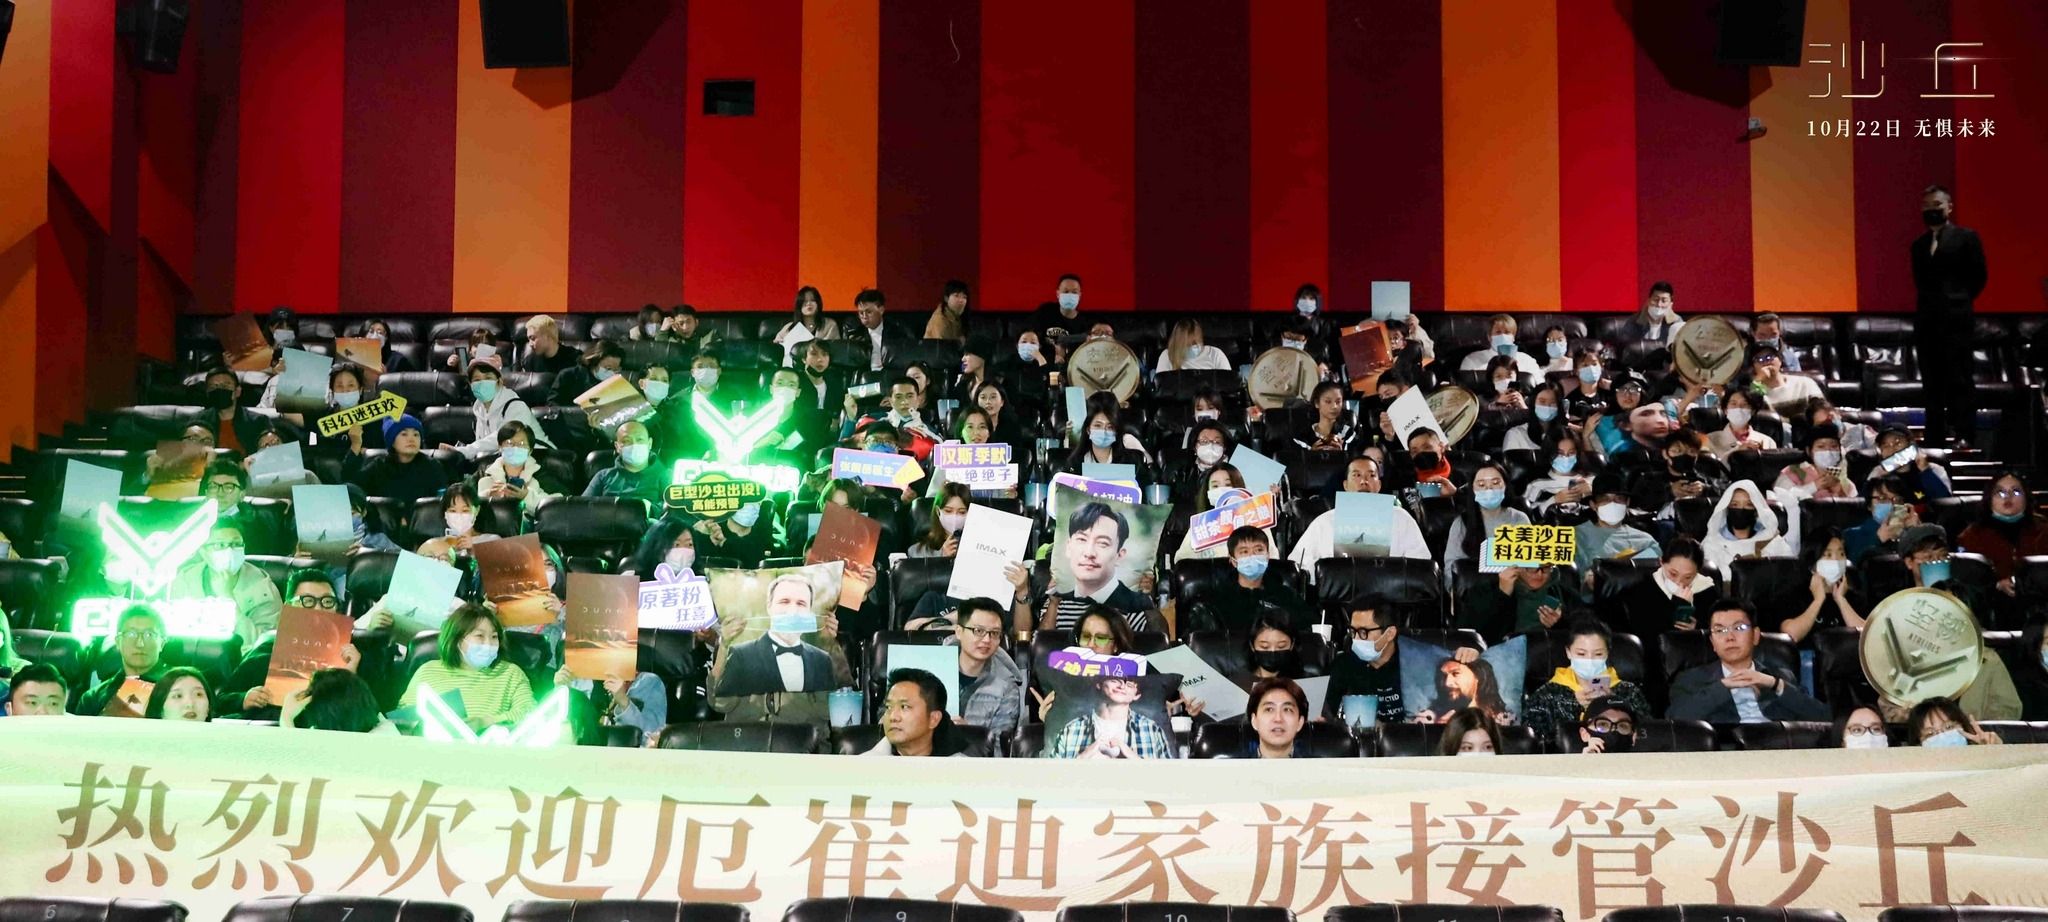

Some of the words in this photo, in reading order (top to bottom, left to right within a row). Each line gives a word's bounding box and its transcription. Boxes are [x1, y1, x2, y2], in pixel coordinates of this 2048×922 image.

[320, 397, 399, 433] 科幻迷狂欢
[942, 446, 1006, 466] 汉斯季默
[964, 468, 1012, 482] 绝绝子
[692, 497, 740, 511] 高能预警
[1495, 526, 1573, 544] 大美沙丘
[975, 542, 1008, 557] IMAX
[1494, 544, 1573, 562] 科幻革新
[638, 585, 702, 610] 原著粉
[676, 605, 707, 623] 狂喜
[45, 762, 1992, 919] 热烈欢迎厄崔迪家族接管沙丘
[46, 904, 57, 919] 6
[342, 906, 354, 922] 7
